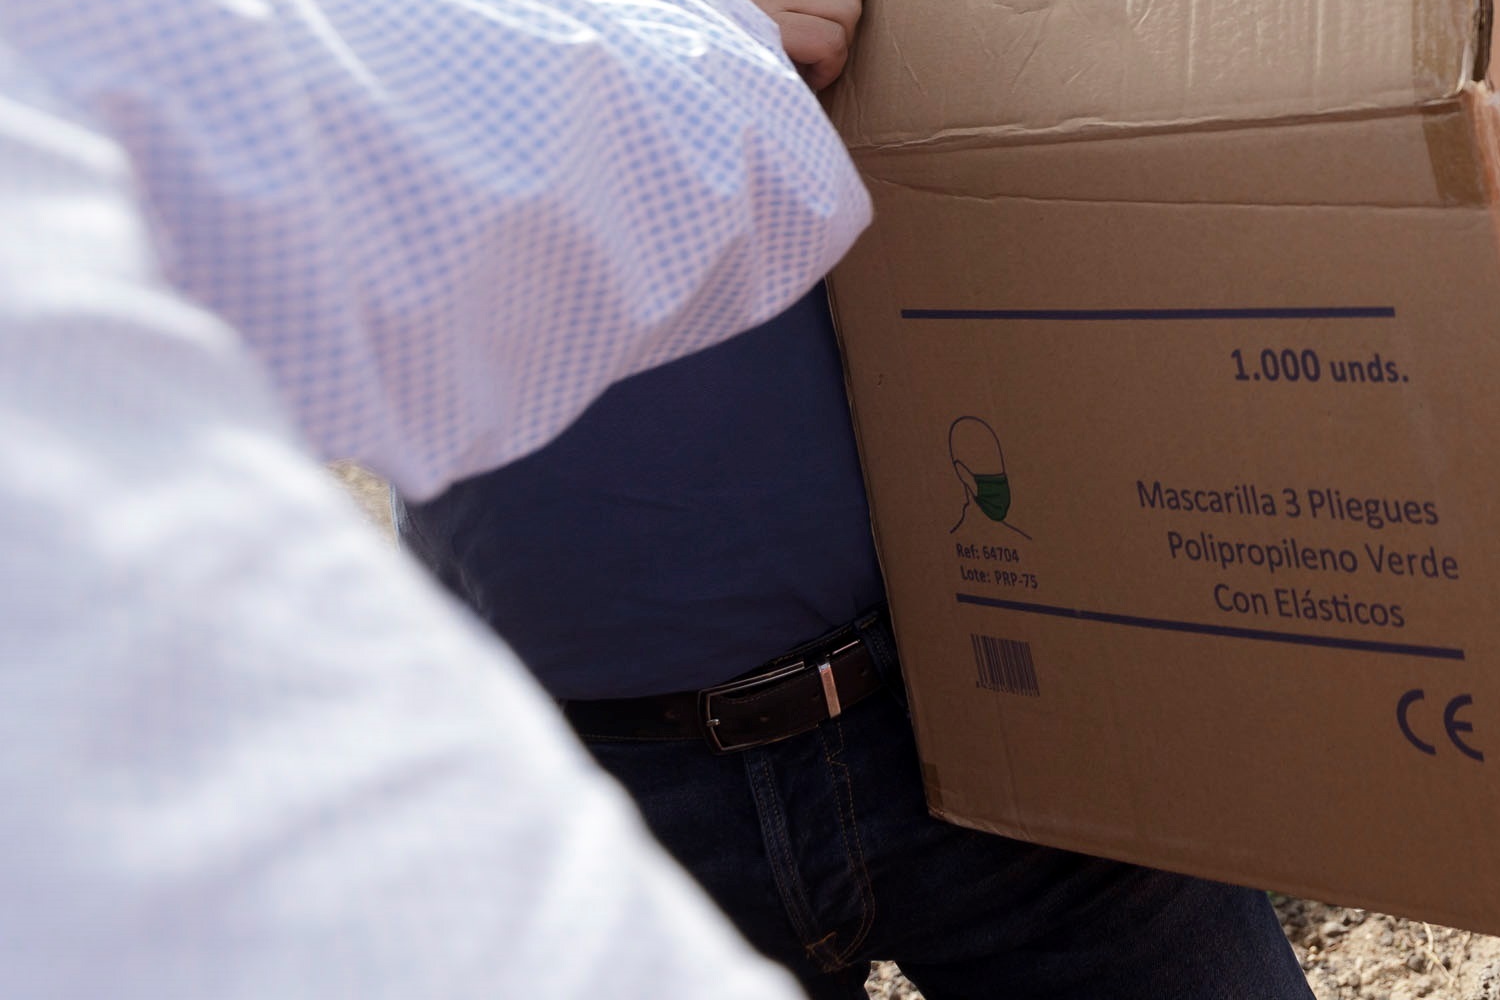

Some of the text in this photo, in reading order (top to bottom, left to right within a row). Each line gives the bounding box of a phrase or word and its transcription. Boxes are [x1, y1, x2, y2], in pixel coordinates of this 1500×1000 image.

[1231, 349, 1409, 383] 1.000 unds.
[1136, 480, 1439, 529] Mascarilla 3 Pliegues
[956, 543, 1020, 563] Ref: 64704
[1167, 531, 1460, 580] Polipropileno Verde
[960, 565, 1038, 589] Lote: PRP-75
[1214, 584, 1406, 628] Con Elásticos
[1396, 689, 1485, 762] CE
